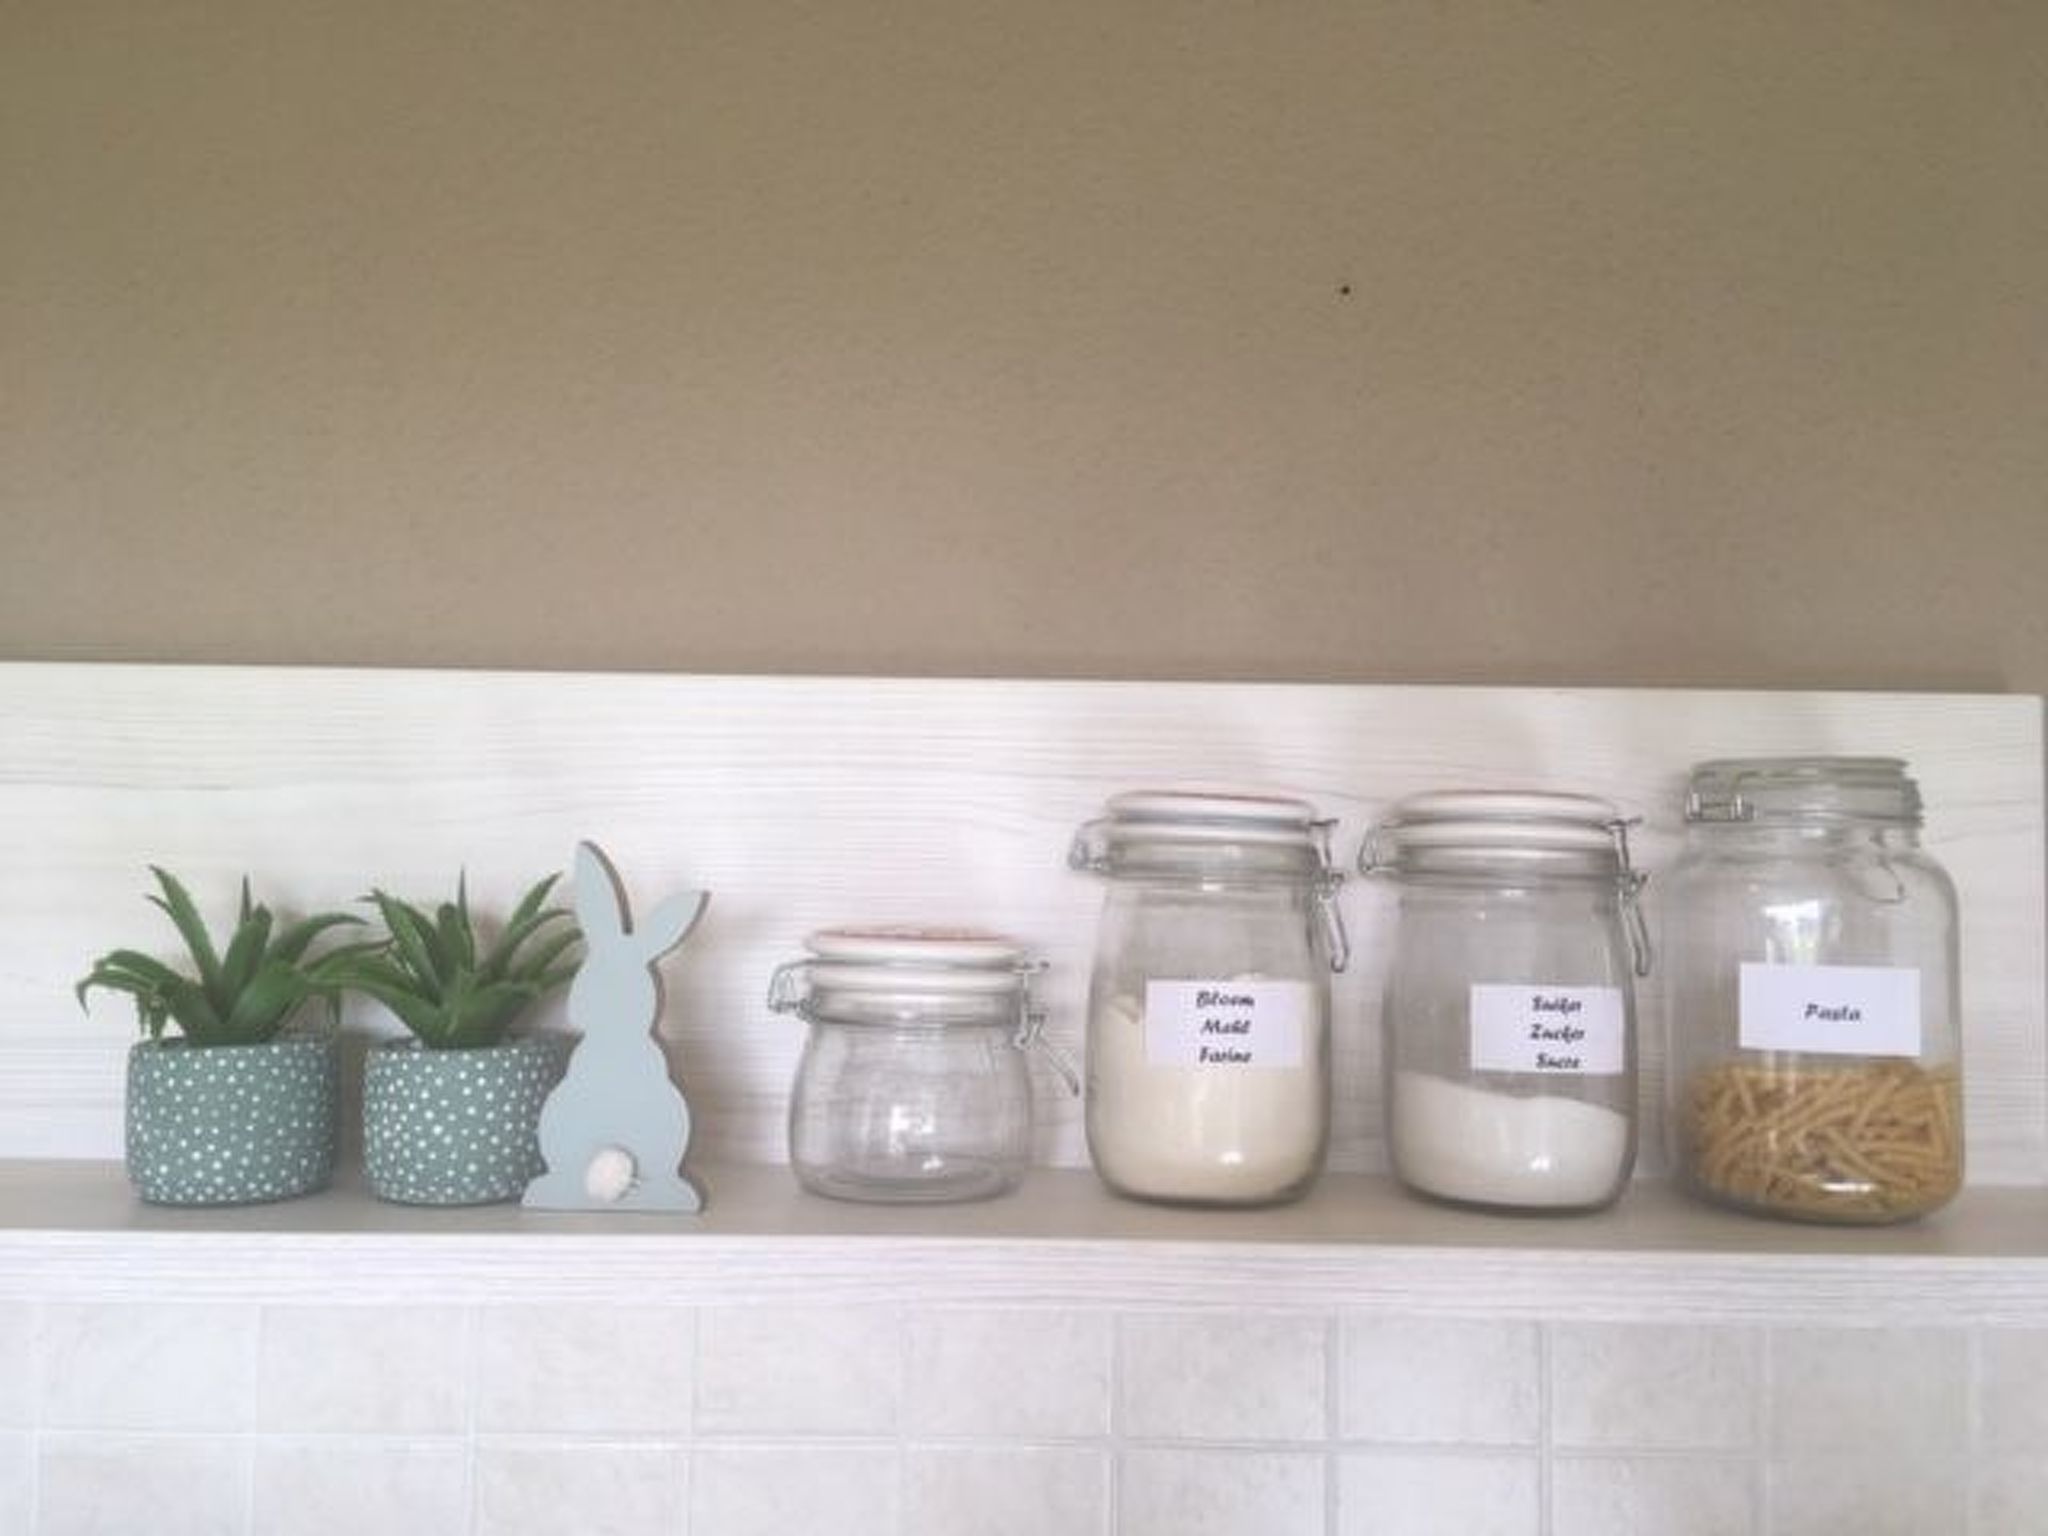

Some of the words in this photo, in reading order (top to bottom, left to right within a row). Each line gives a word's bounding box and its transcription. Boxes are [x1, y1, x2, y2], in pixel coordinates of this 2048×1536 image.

[1804, 1003, 1861, 1021] Pasta
[1530, 1024, 1586, 1043] Zucker
[1198, 1046, 1252, 1063] Farine
[1536, 1053, 1580, 1069] Sucre
